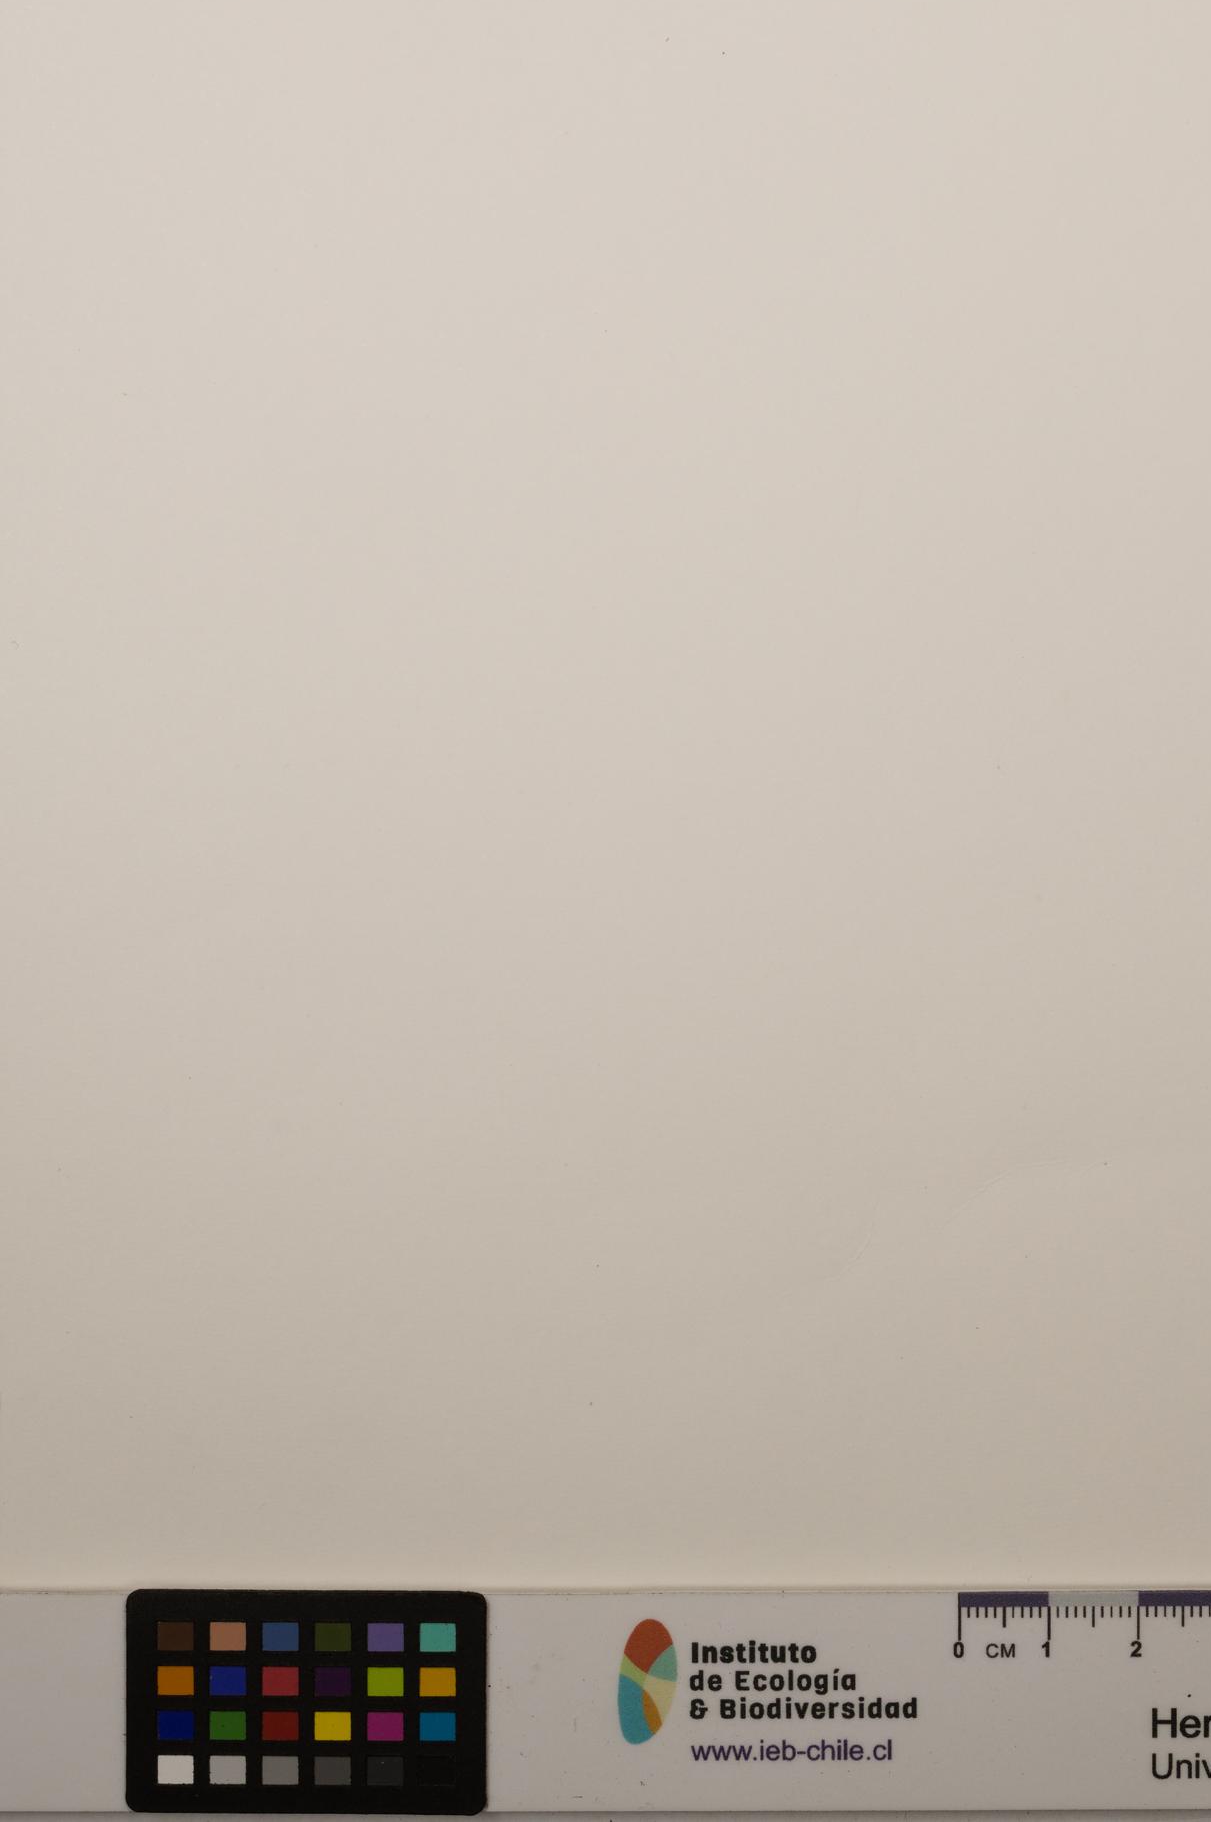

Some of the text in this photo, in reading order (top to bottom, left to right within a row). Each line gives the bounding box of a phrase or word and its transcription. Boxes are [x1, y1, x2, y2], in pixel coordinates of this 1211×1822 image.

[691, 1641, 817, 1664] Instituto
[953, 1641, 965, 1659] 0
[985, 1643, 1016, 1658] CM
[1041, 1641, 1050, 1658] 1
[1130, 1641, 1142, 1658] 2
[689, 1668, 857, 1696] de Ecología
[689, 1696, 918, 1720] & Biodiversidad
[690, 1738, 893, 1762] www.ieb-chile.cl
